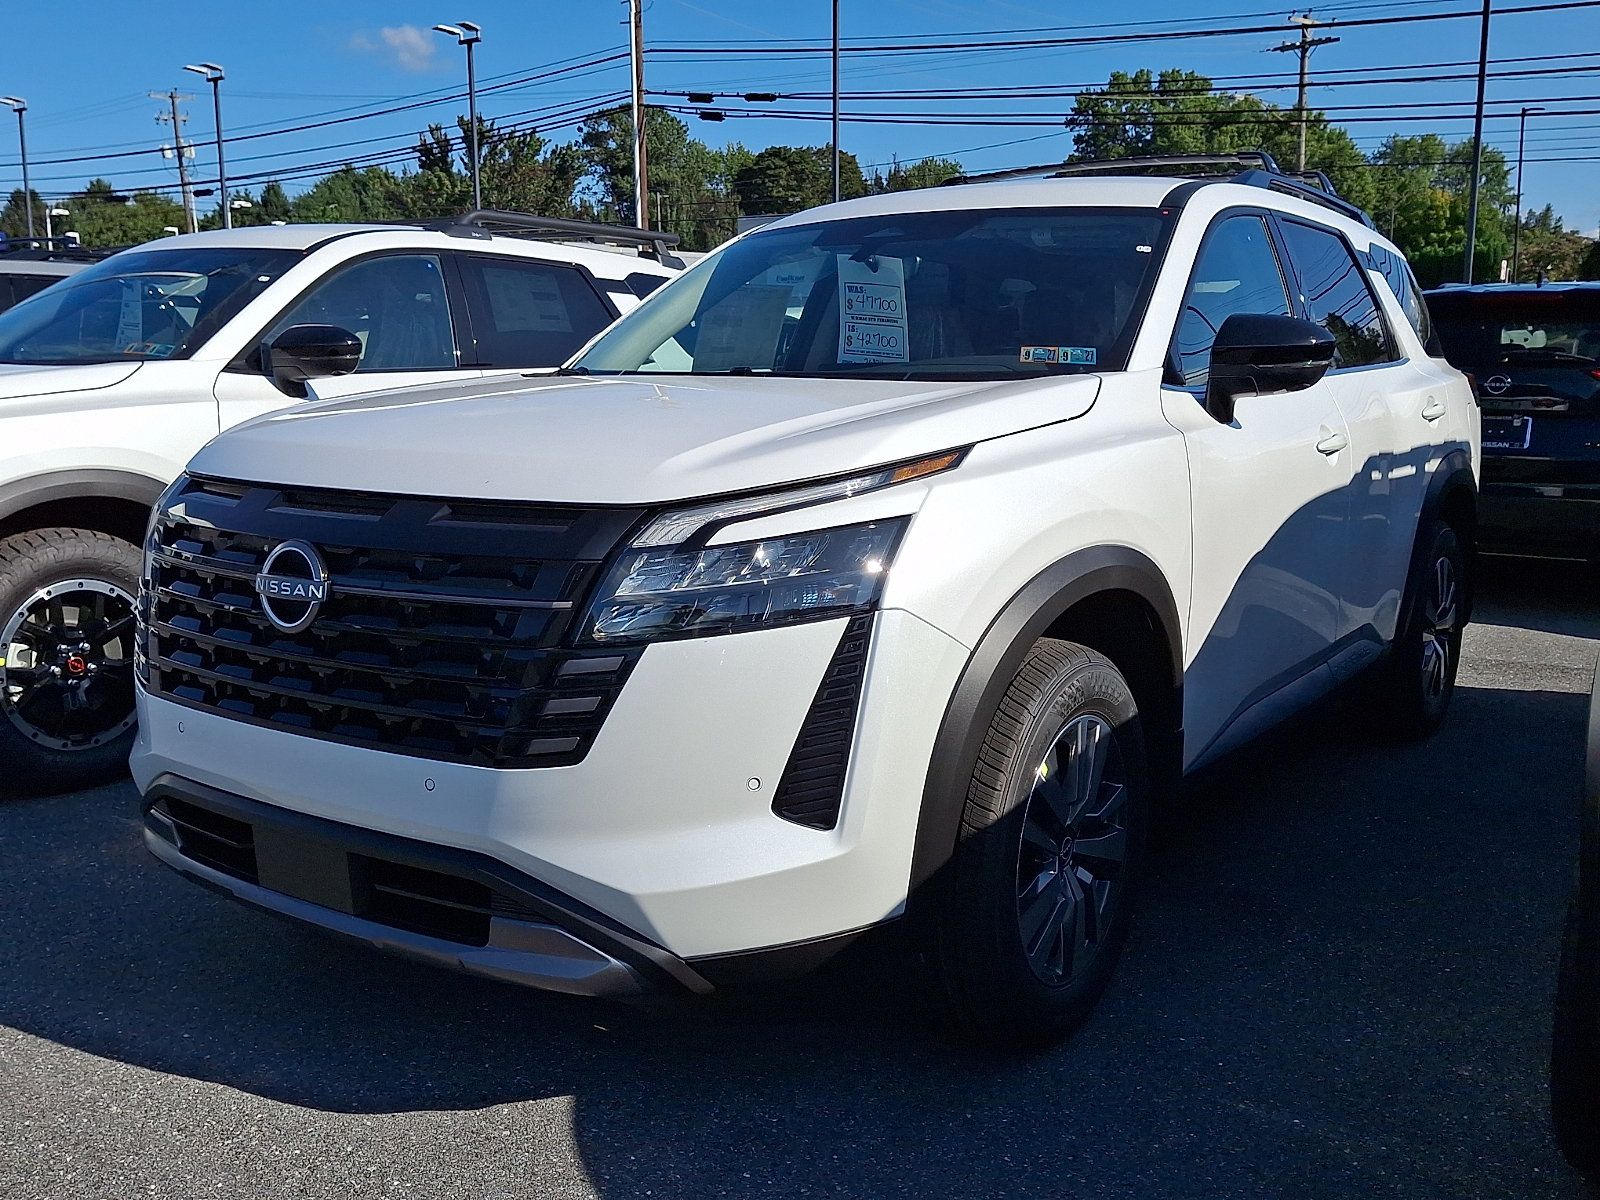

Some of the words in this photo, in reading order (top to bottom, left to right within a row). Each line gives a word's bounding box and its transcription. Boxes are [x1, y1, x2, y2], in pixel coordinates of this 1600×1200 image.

[847, 286, 867, 294] WAS:
[847, 324, 859, 333] IS:
[856, 332, 898, 348] 42700
[1062, 351, 1069, 362] 9
[256, 577, 323, 599] NISSAN
